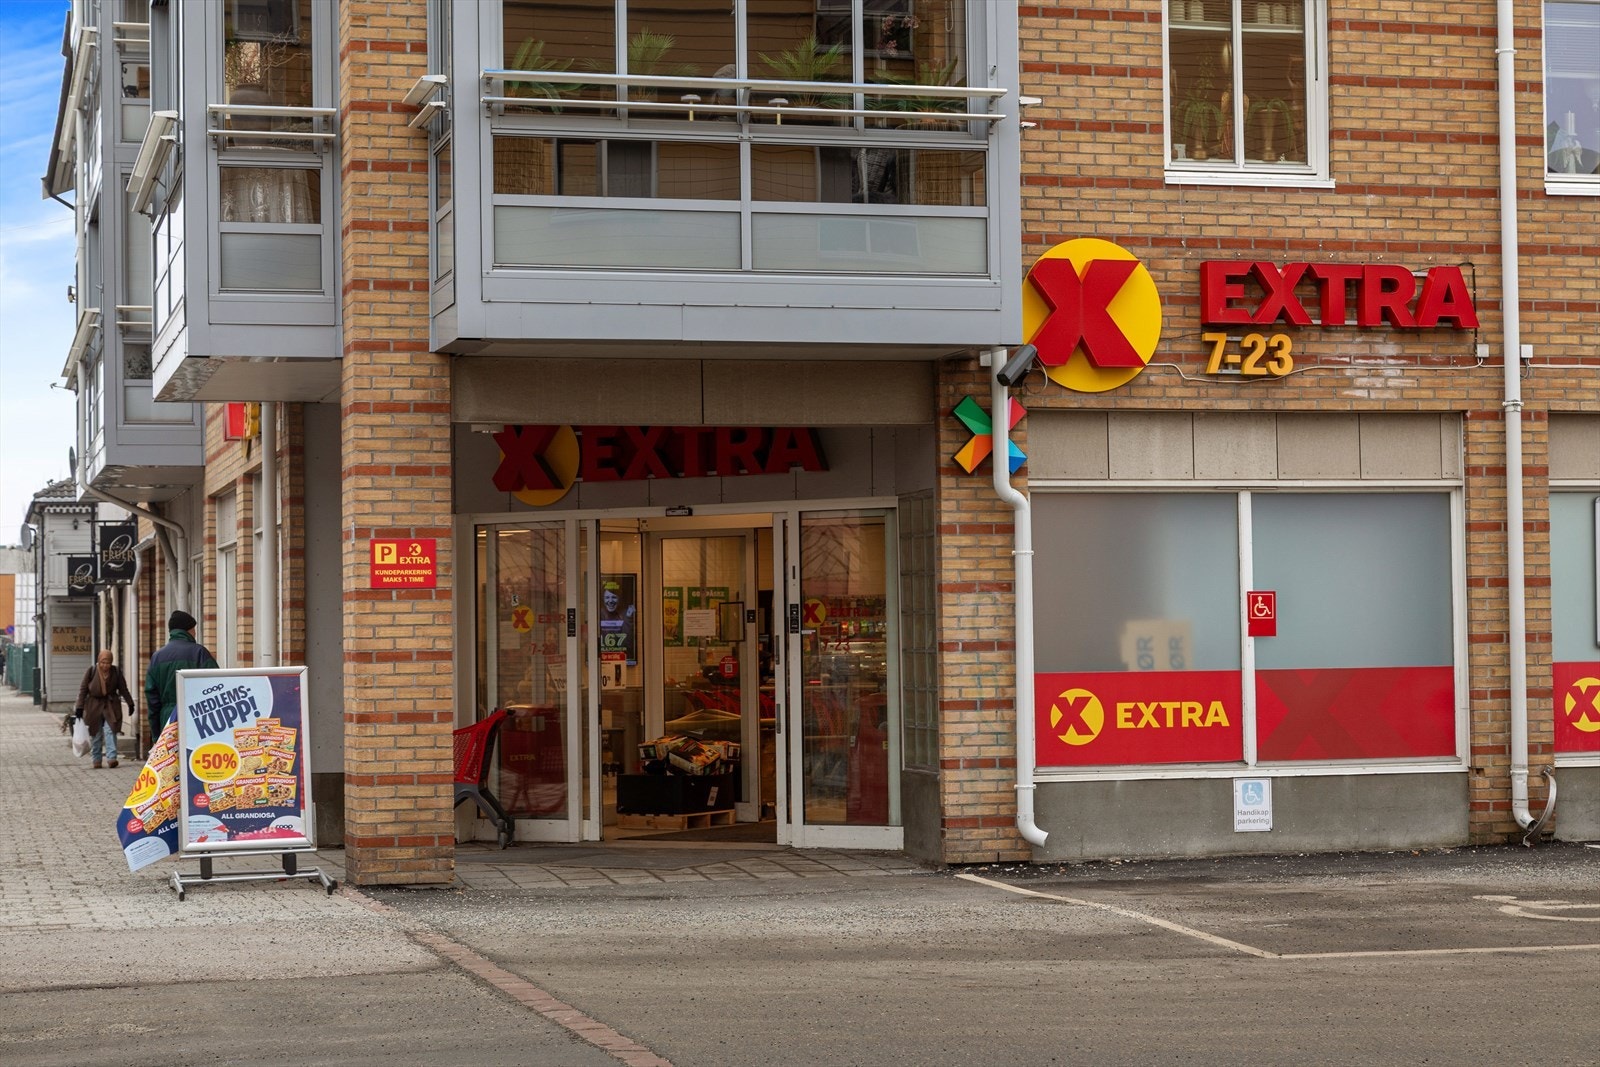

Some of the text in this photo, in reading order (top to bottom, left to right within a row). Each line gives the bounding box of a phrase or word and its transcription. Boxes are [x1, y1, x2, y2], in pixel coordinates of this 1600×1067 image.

[1200, 260, 1480, 328] EXTRA
[1202, 332, 1294, 376] 7-23
[579, 426, 829, 482] EXTRA
[381, 546, 393, 562] P
[400, 557, 431, 565] EXTRA
[52, 626, 77, 634] KATE
[73, 635, 92, 643] THA
[202, 683, 224, 695] coop
[188, 685, 251, 718] MEDLEMS-
[193, 696, 261, 739] KUPP!
[1116, 701, 1230, 728] EXTRA
[239, 749, 263, 757] RANDIOSA
[509, 754, 536, 762] EXTRA
[195, 753, 237, 770] -50%
[208, 779, 234, 789] GRANDIOS
[236, 777, 265, 785] GRANDIOSA
[1237, 809, 1269, 817] Handikap
[1237, 817, 1270, 825] parkering
[158, 826, 171, 835] ALL
